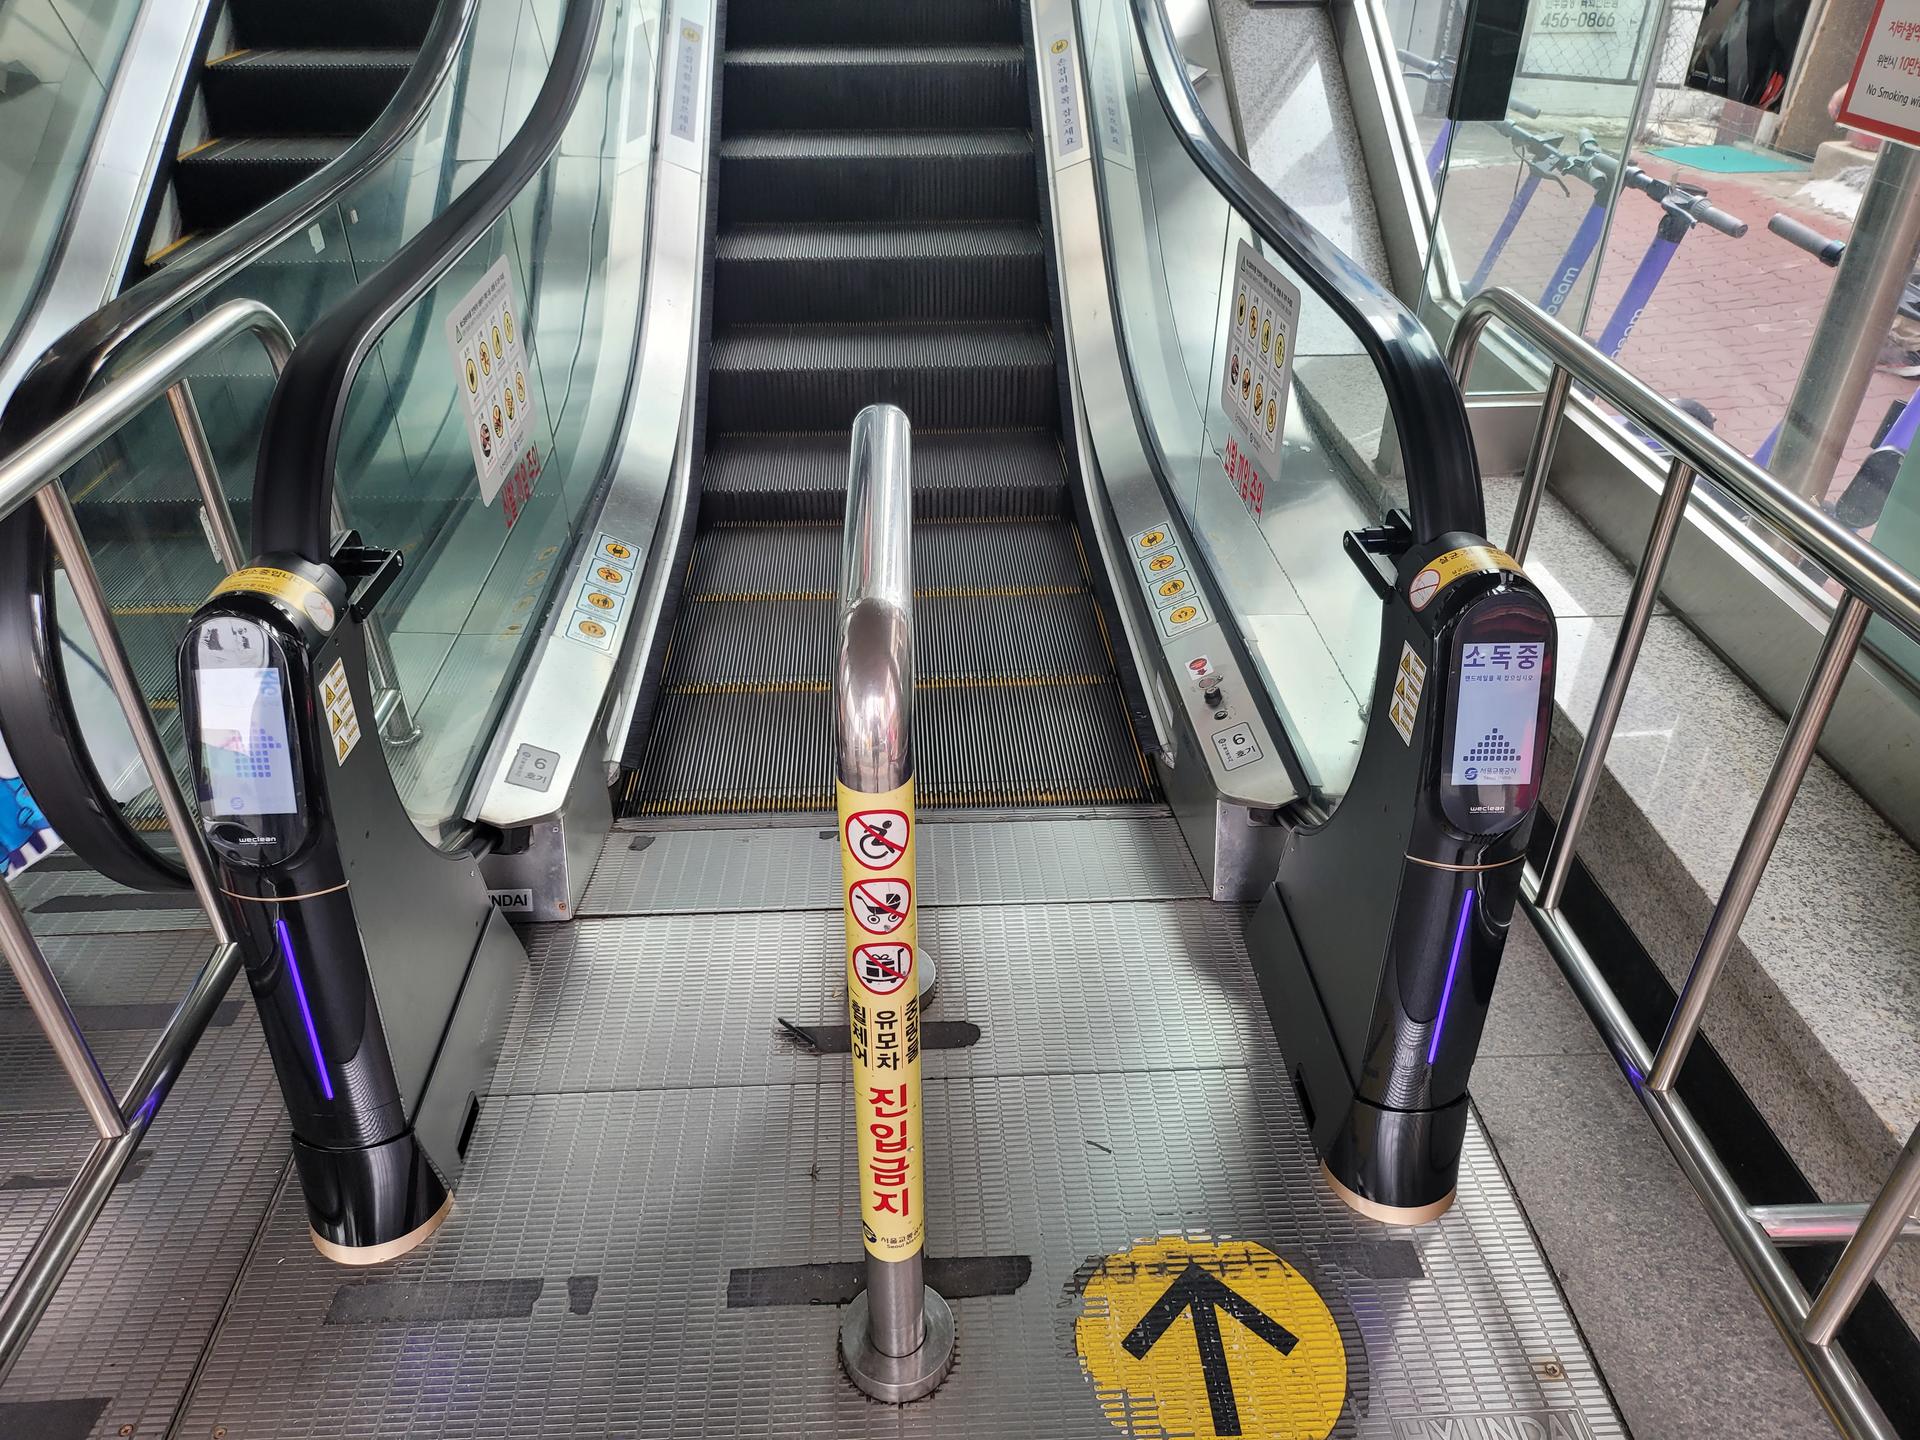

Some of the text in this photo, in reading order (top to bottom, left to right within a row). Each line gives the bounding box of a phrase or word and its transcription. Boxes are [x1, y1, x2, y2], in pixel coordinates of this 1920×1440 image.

[1541, 12, 1616, 28] 456-0866
[1876, 54, 1898, 70] 위반시
[1866, 83, 1878, 96] No
[1878, 87, 1909, 107] Smoking
[1063, 107, 1076, 146] 잡으세요
[1464, 645, 1538, 670] 소독중
[1233, 734, 1246, 746] 6
[534, 758, 548, 770] 6
[1470, 805, 1505, 813] weclean
[852, 999, 868, 1068] 휠체어
[874, 1010, 900, 1071] 유모차
[904, 994, 919, 1065] 중량물
[868, 1083, 910, 1217] 진입금지
